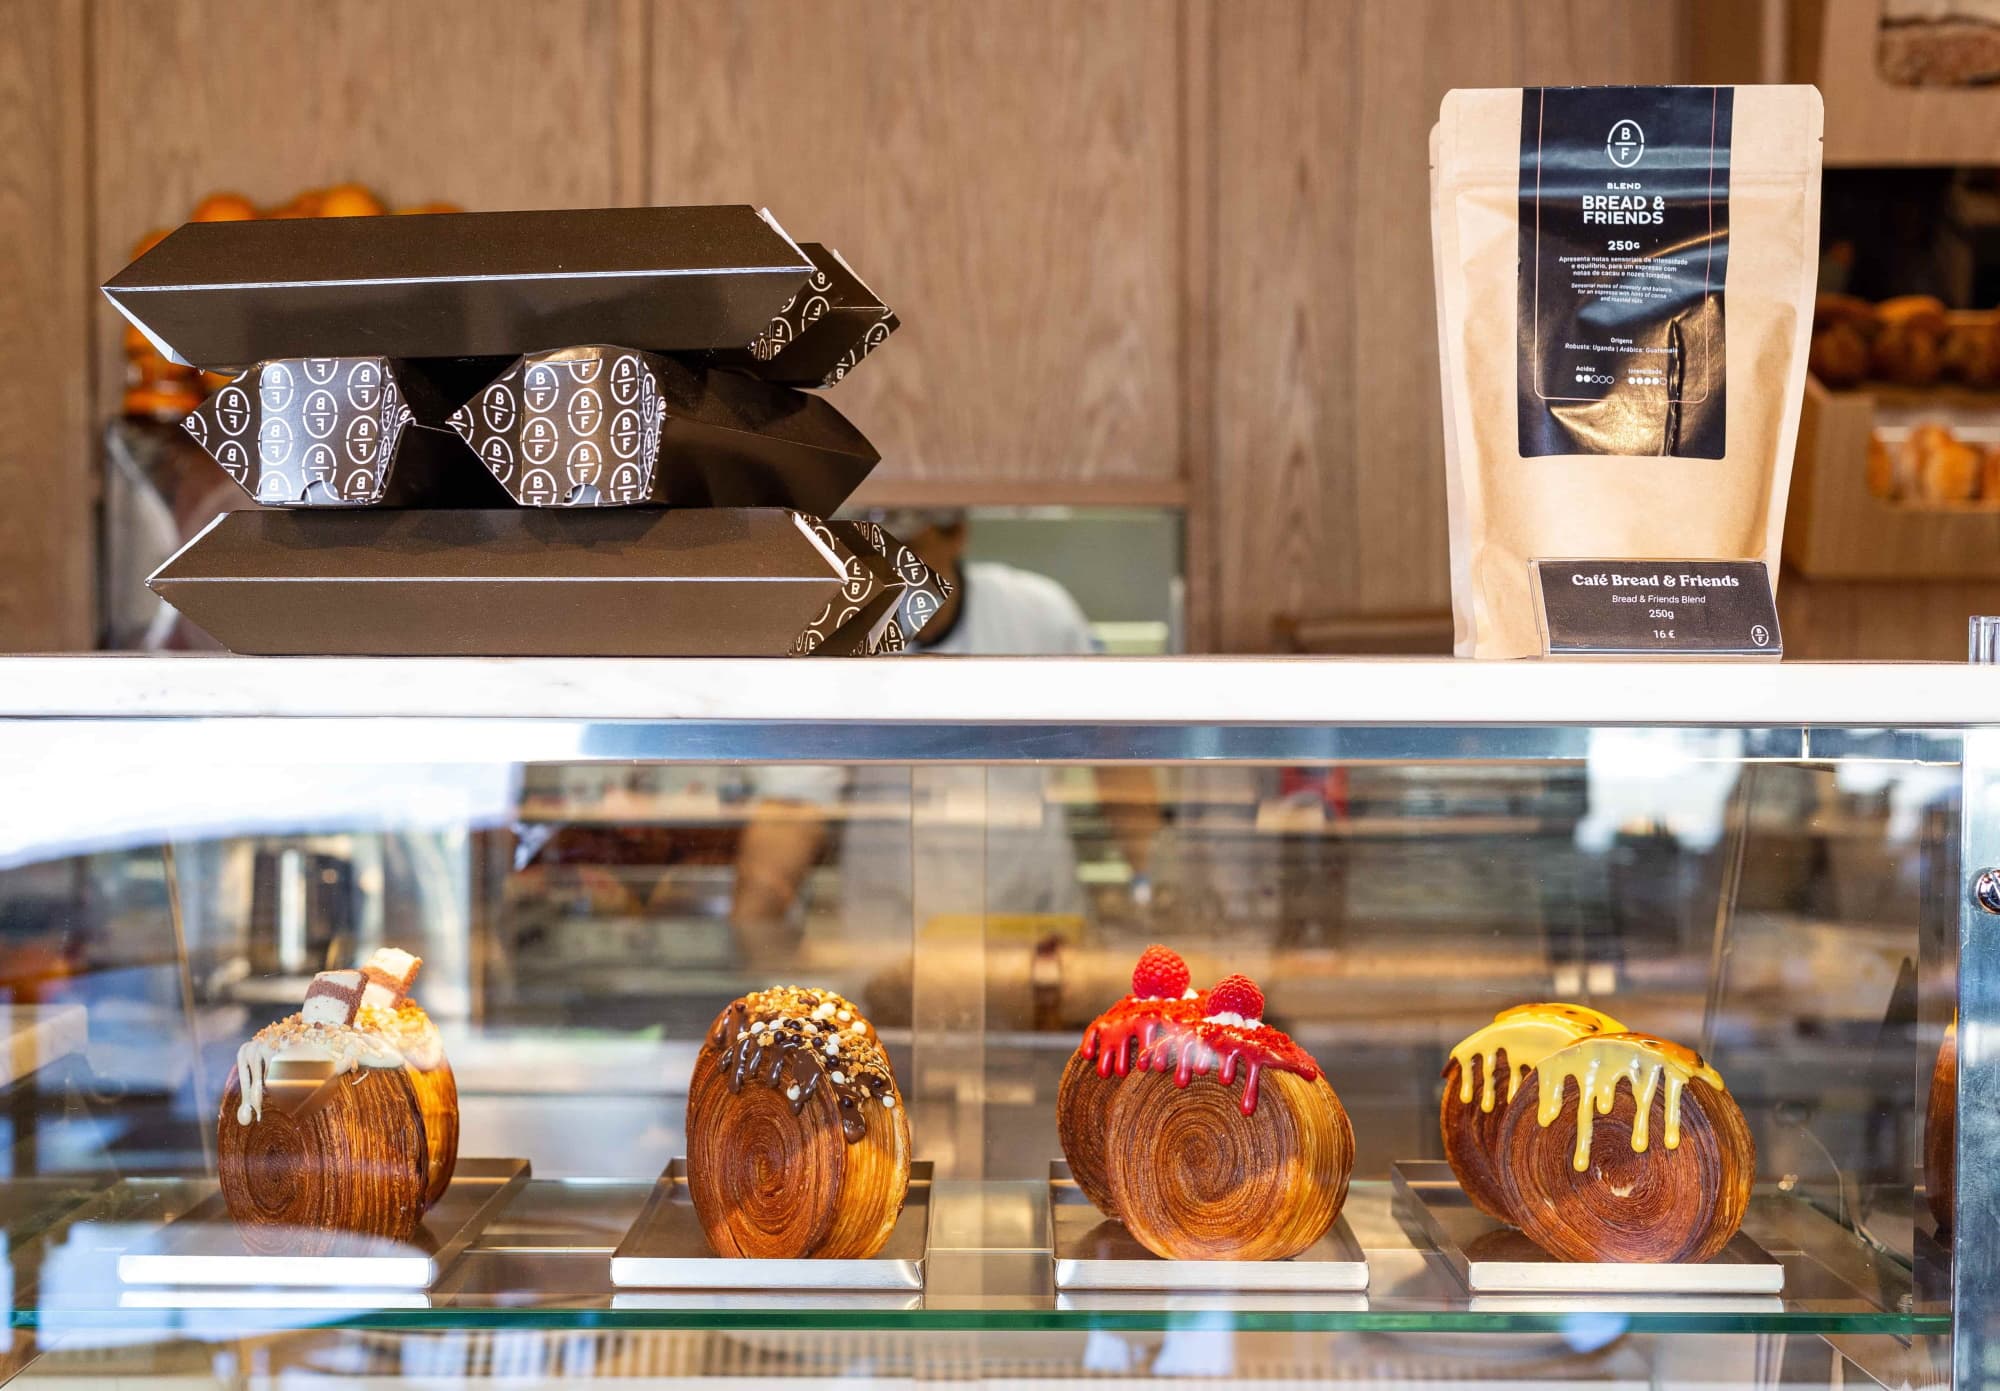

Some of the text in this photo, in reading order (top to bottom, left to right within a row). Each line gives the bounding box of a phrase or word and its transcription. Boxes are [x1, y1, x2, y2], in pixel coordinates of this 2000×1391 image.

[1621, 128, 1630, 140] B
[1621, 148, 1629, 160] F
[1583, 196, 1665, 210] BREAD &
[1584, 211, 1664, 225] FRIENDS
[1611, 337, 1633, 345] Origens
[1593, 344, 1615, 352] Uganda
[582, 364, 589, 376] F
[621, 363, 629, 376] B
[536, 372, 545, 385] B
[622, 386, 630, 398] F
[496, 392, 505, 405] B
[536, 393, 544, 405] F
[580, 396, 589, 408] B
[494, 413, 503, 425] F
[581, 417, 589, 429] F
[622, 417, 631, 430] B
[535, 425, 544, 438] B
[493, 444, 502, 456] B
[535, 444, 544, 457] F
[623, 439, 631, 451] F
[580, 449, 589, 462] B
[533, 477, 543, 489] B
[622, 471, 631, 483] B
[1572, 574, 1739, 587] Café Bread & Friends
[1612, 595, 1637, 603] Bread
[1648, 595, 1679, 603] Friends
[1649, 609, 1674, 619] 250g
[1653, 630, 1675, 638] 16 €
